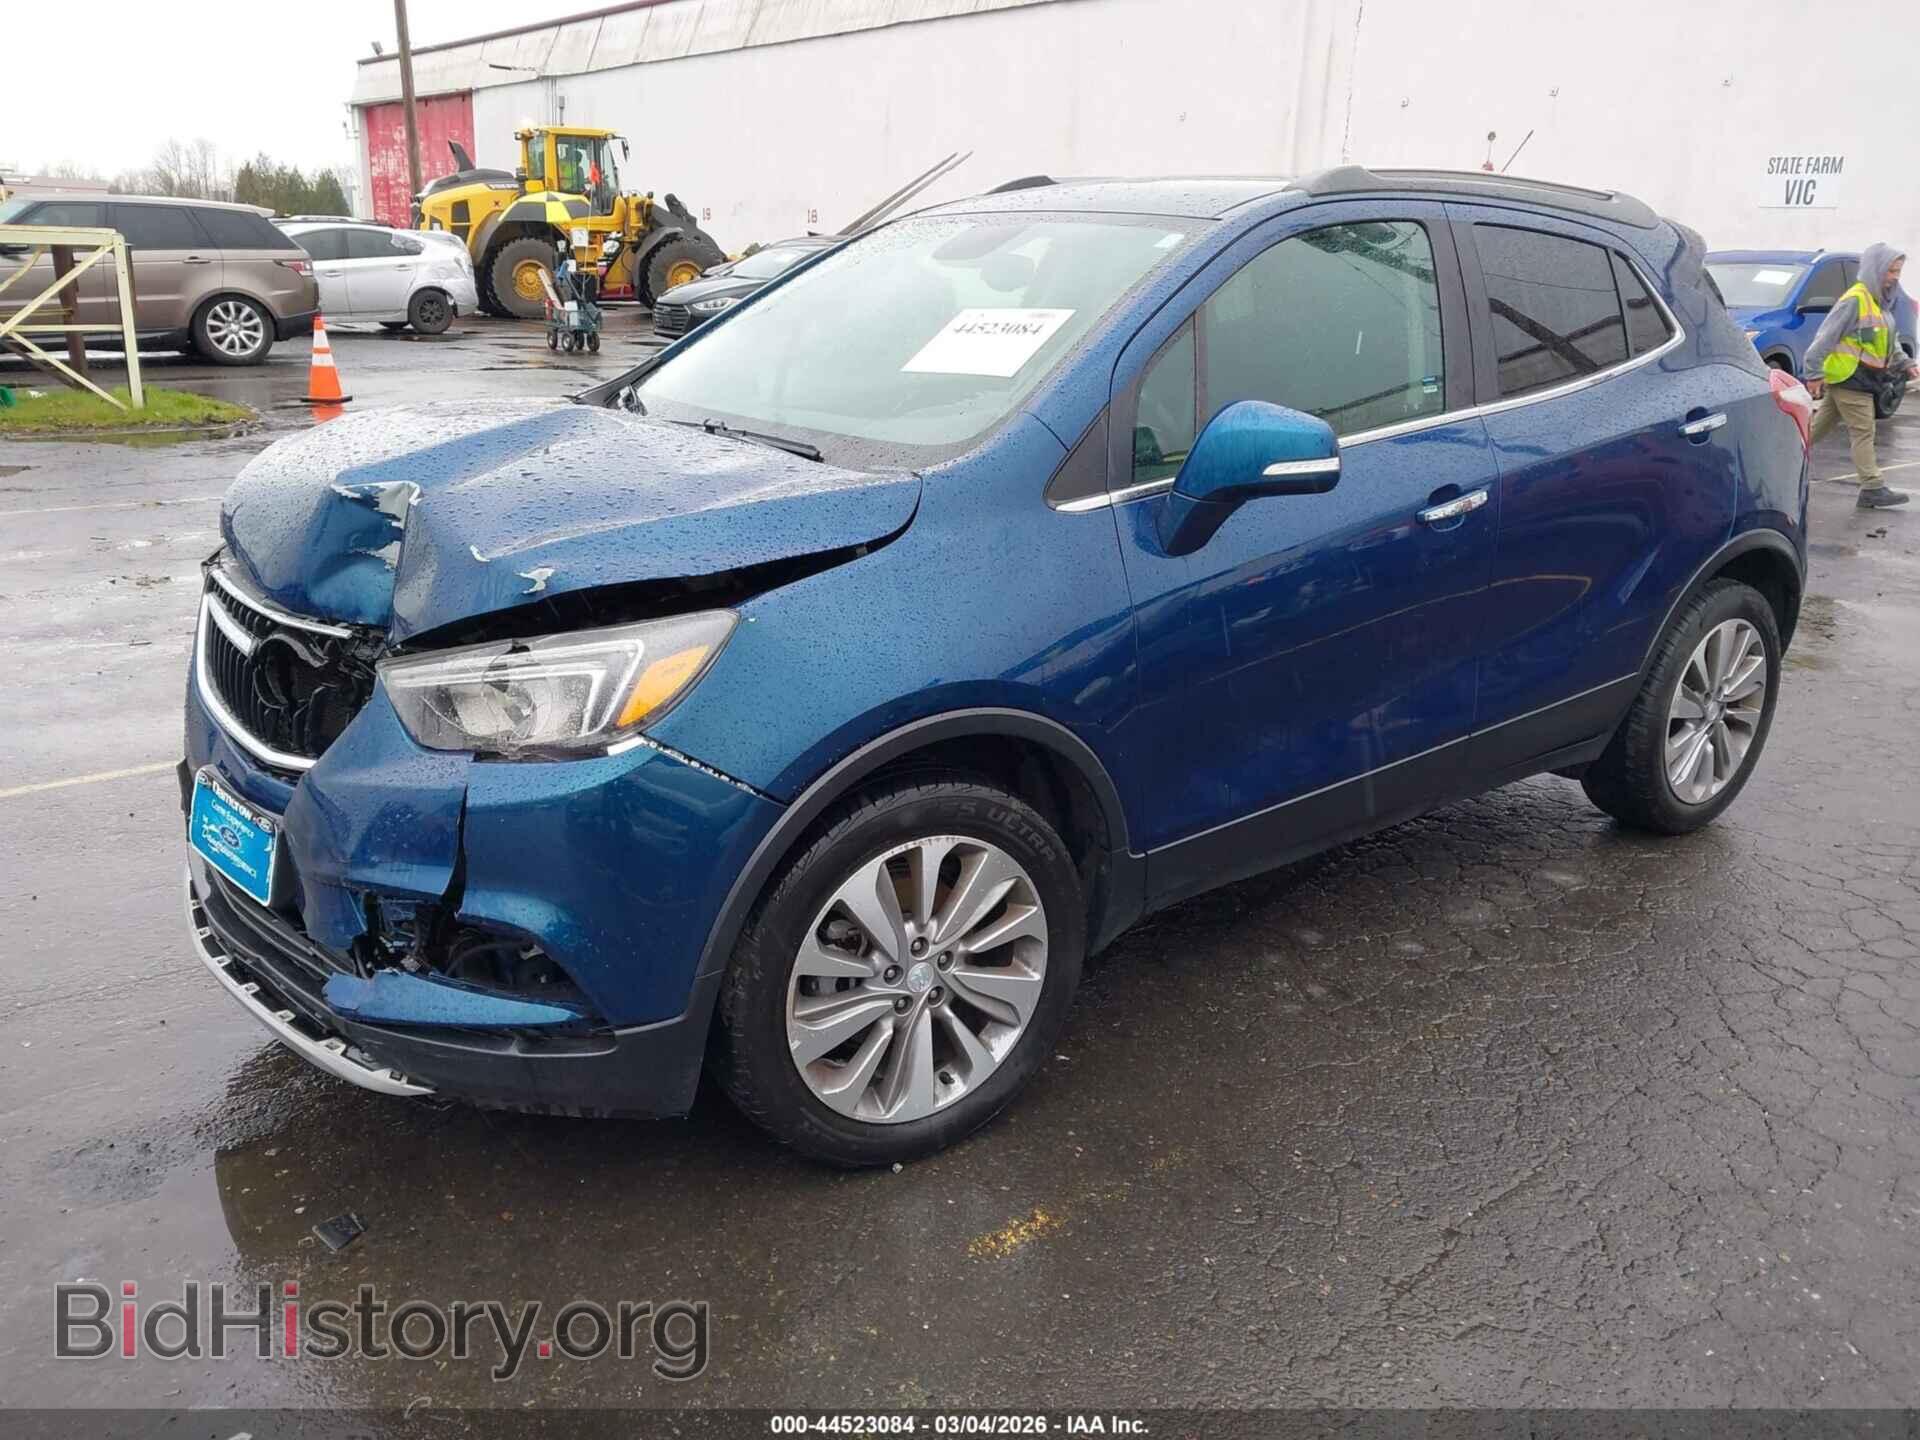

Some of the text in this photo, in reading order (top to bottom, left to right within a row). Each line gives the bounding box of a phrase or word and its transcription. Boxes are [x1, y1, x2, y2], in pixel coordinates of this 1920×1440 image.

[1767, 156, 1844, 175] STATE FARM
[1784, 179, 1817, 205] VIC
[953, 322, 1044, 335] 44523084
